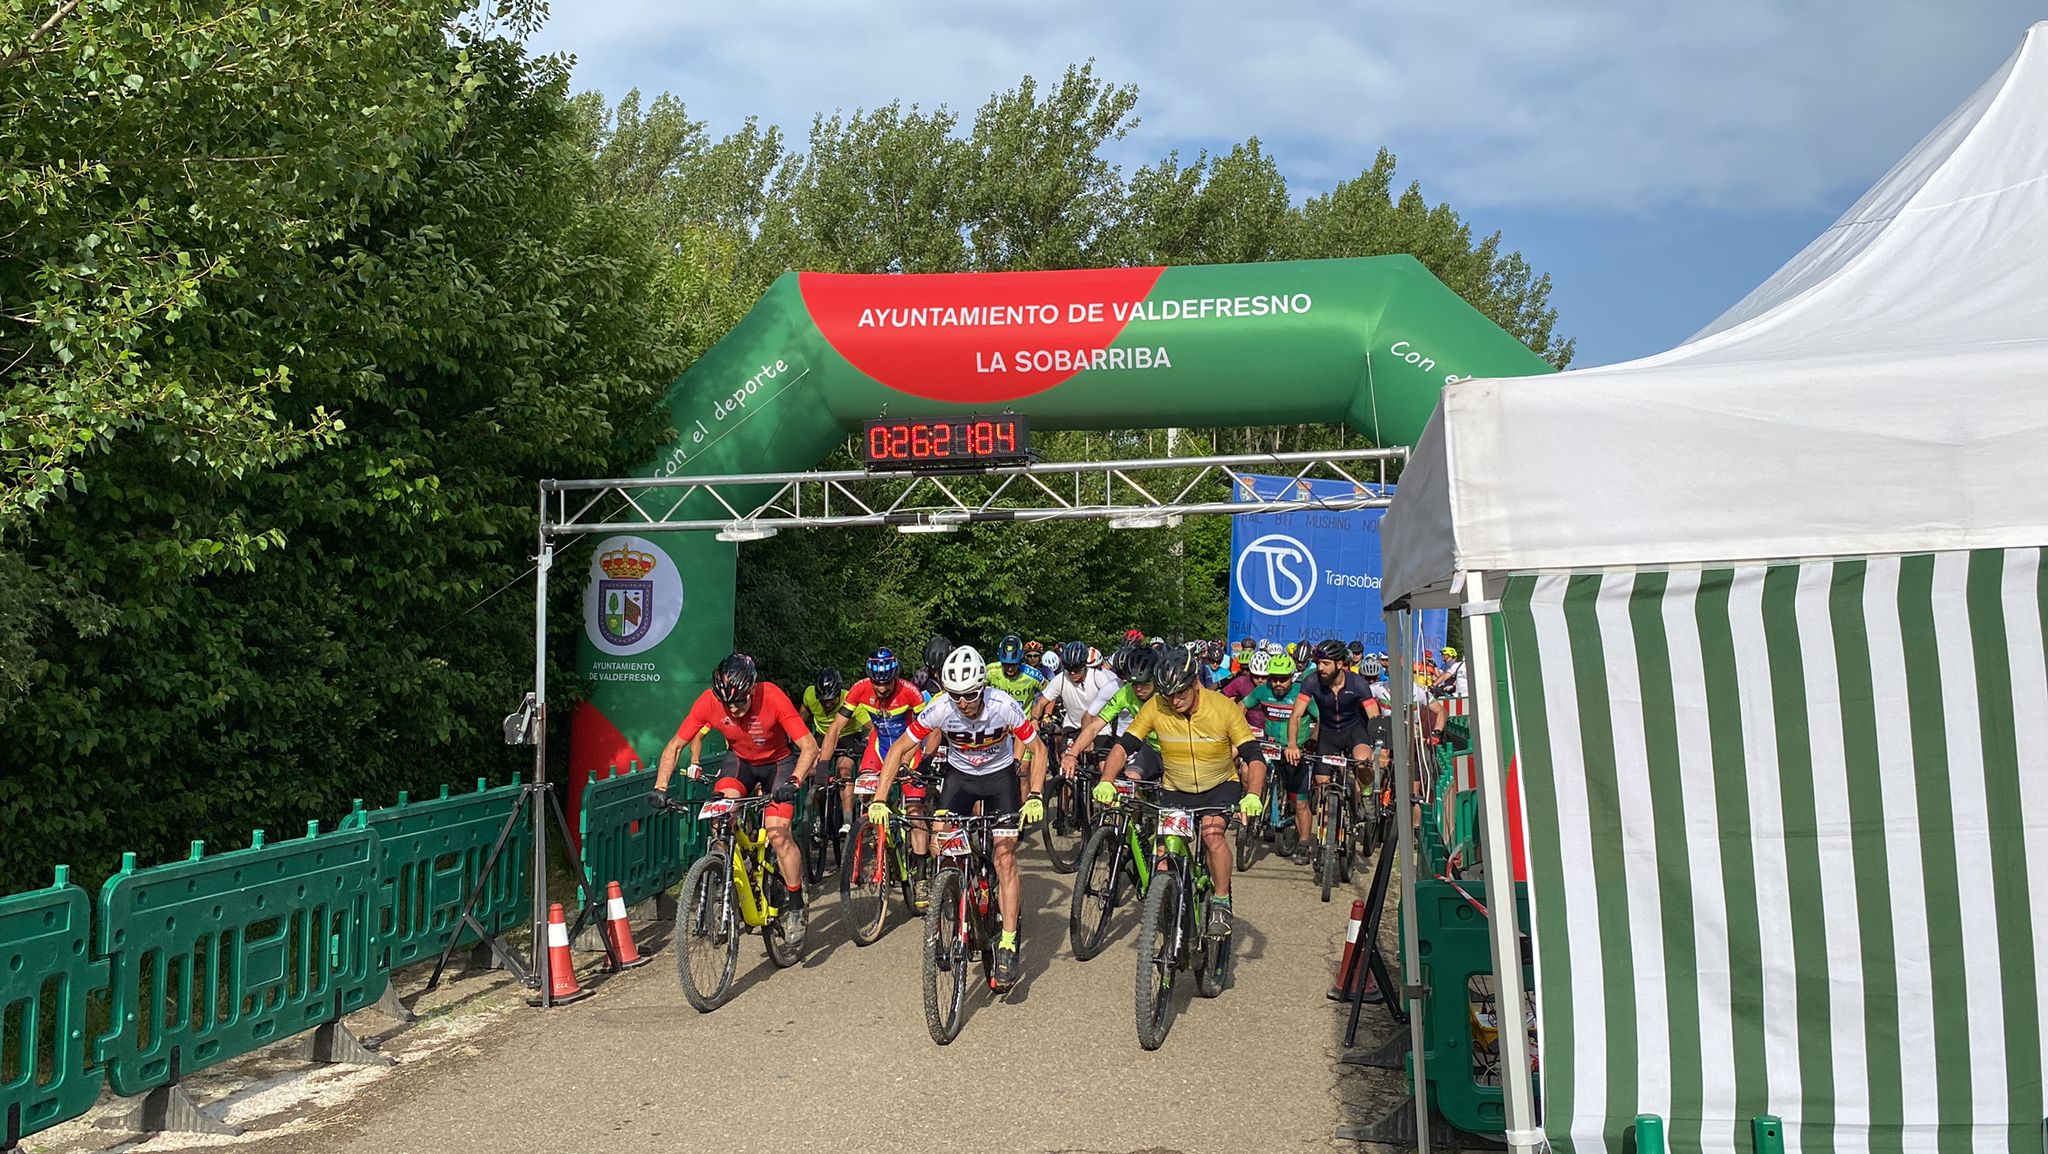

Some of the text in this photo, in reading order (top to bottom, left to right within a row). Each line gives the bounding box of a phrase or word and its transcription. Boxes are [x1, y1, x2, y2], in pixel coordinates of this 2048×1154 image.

[858, 293, 1312, 328] AYUNTAMIENTO DE VALDEFRESNO
[976, 346, 1172, 374] LA SOBARRIBA
[1390, 341, 1435, 372] Con
[692, 419, 709, 443] el
[713, 359, 788, 421] deporte
[1305, 514, 1351, 531] MUSHING
[1325, 570, 1383, 589] Transobar
[1231, 621, 1254, 637] TRAIL
[1266, 624, 1287, 638] BTT
[1297, 627, 1344, 641] MUSHING
[1355, 631, 1386, 647] NORDI
[589, 672, 661, 682] DE VALDEFRESNO
[593, 662, 656, 671] AYUNTAMIENTO
